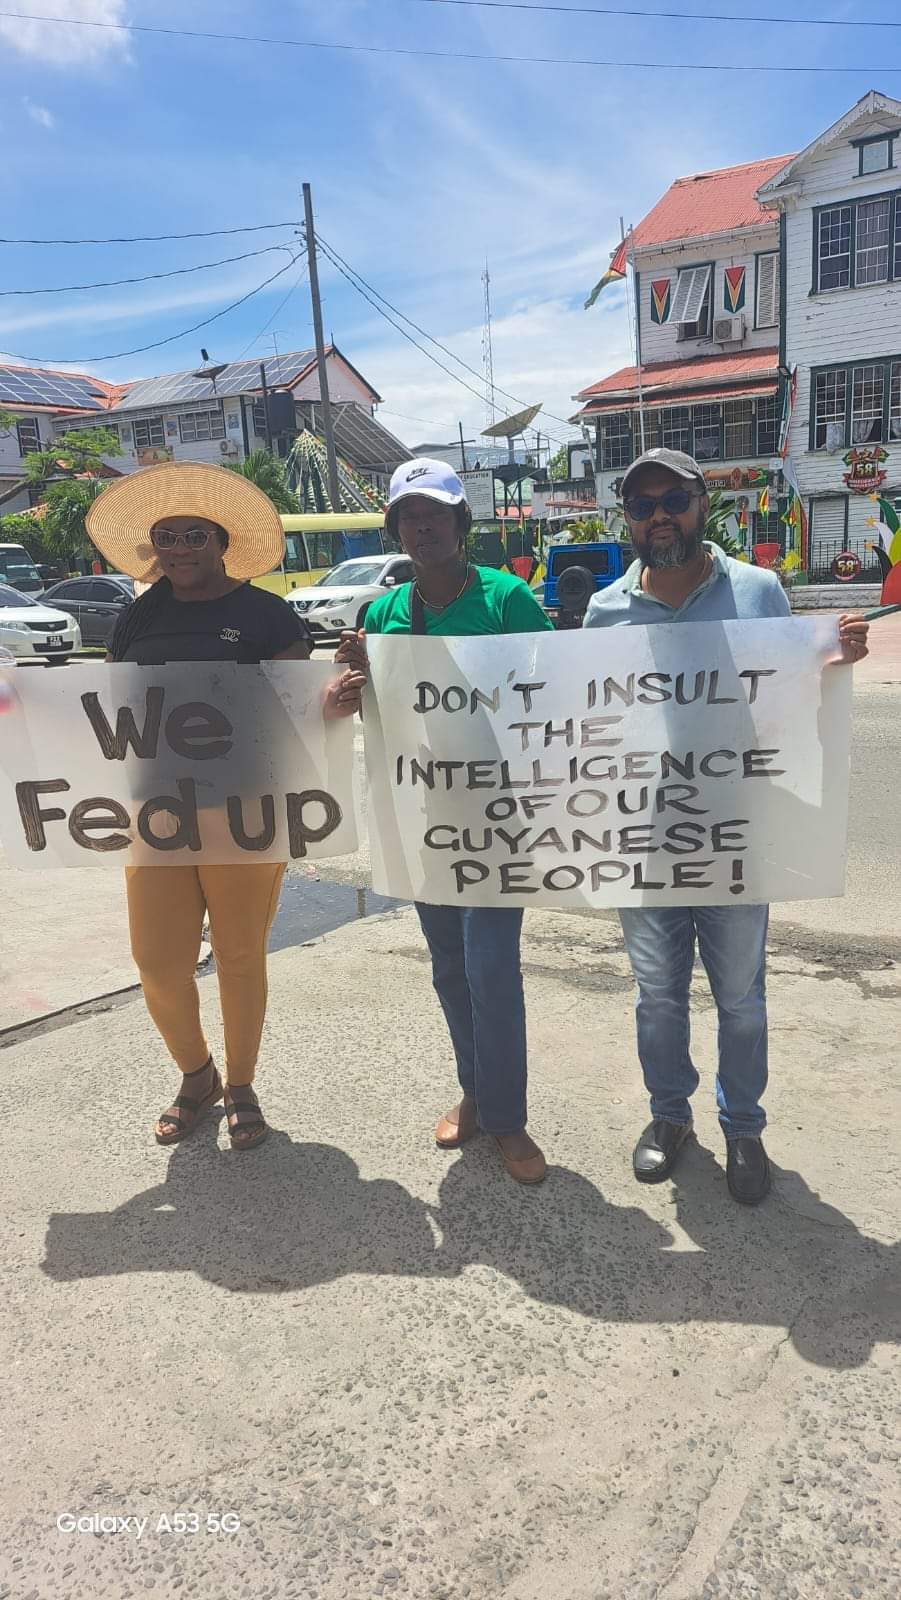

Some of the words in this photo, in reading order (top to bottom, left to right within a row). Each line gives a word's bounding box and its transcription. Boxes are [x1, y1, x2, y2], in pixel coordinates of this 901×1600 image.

[413, 669, 546, 713] DON'T
[587, 668, 778, 709] INSULT
[81, 686, 234, 761] We
[507, 714, 625, 752] THE
[396, 748, 787, 790] INTELLIGENCE
[15, 778, 203, 852] Fed
[226, 789, 343, 859] up
[423, 819, 750, 855] GUYANESE
[450, 858, 745, 896] PEOPLE!
